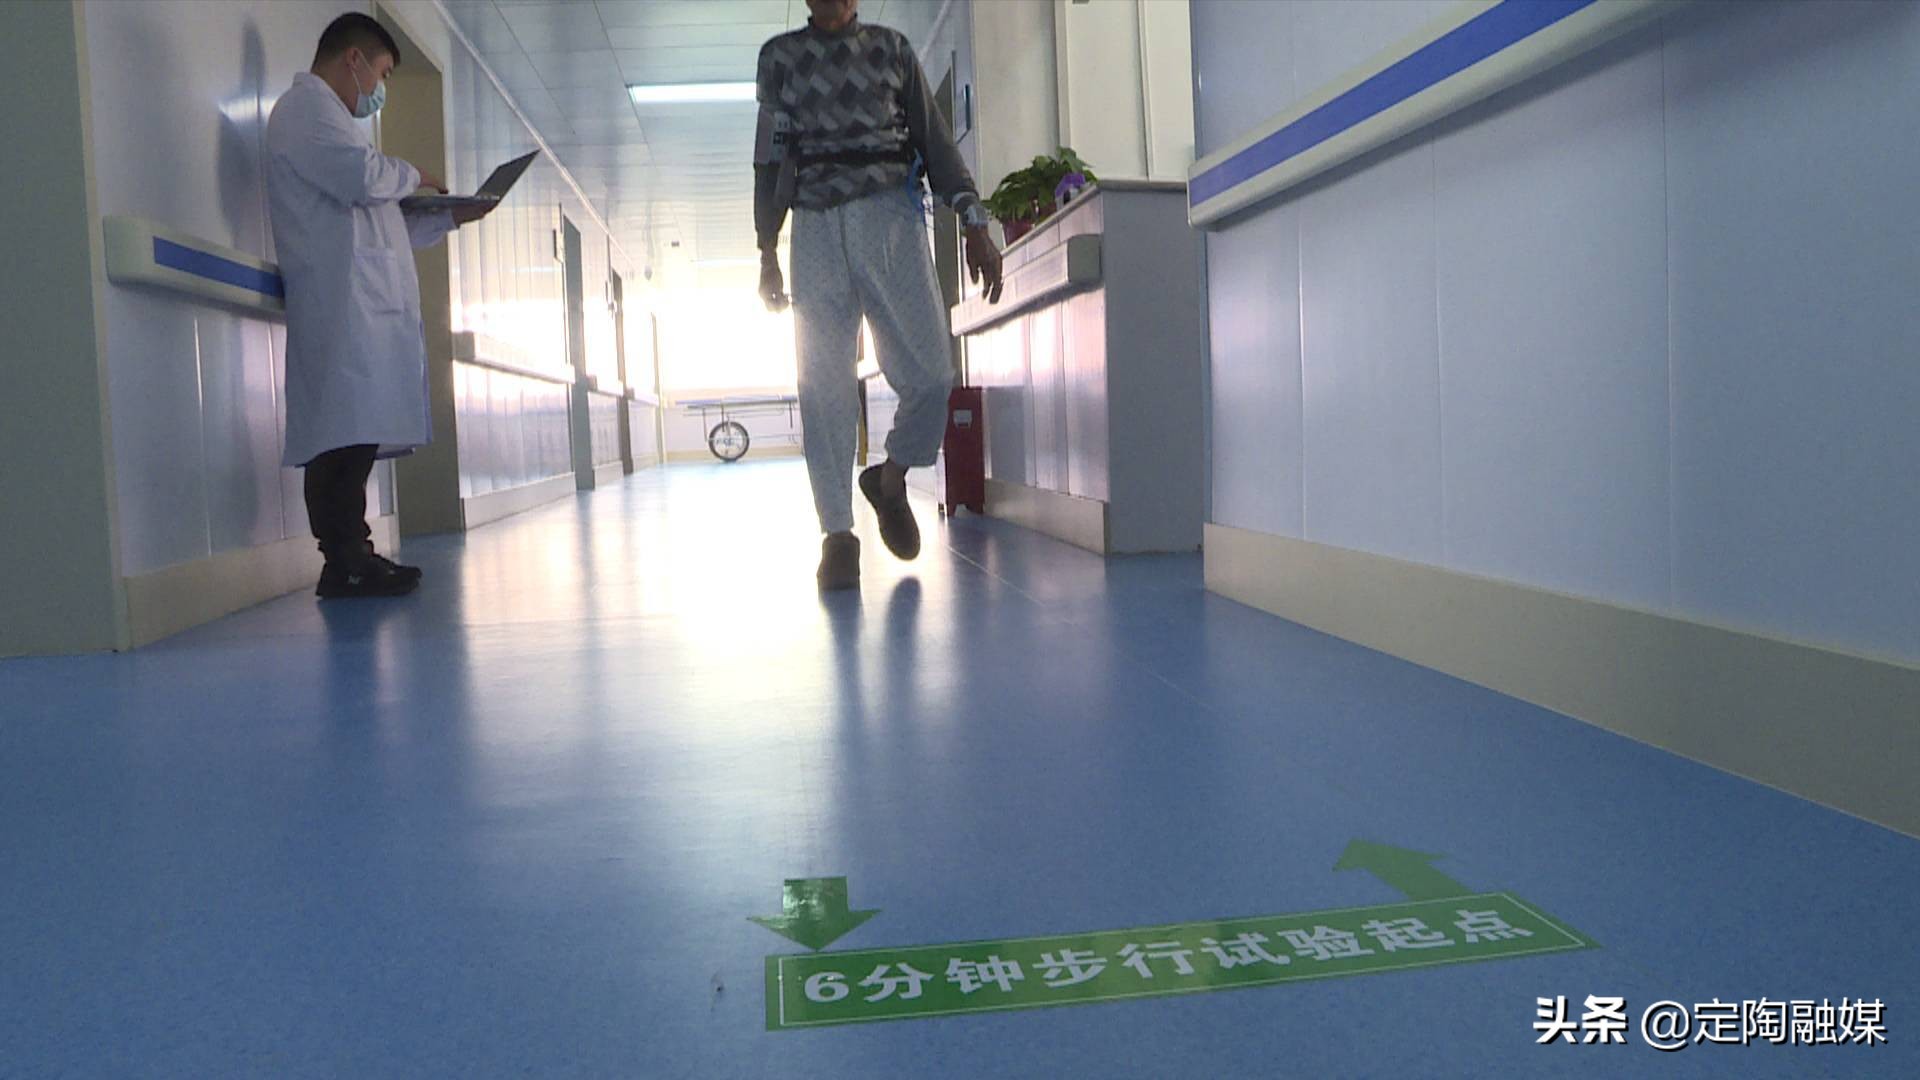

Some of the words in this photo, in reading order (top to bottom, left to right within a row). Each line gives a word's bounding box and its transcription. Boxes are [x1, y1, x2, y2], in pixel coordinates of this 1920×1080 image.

[802, 907, 1534, 1003] 6分钟步行试验起点
